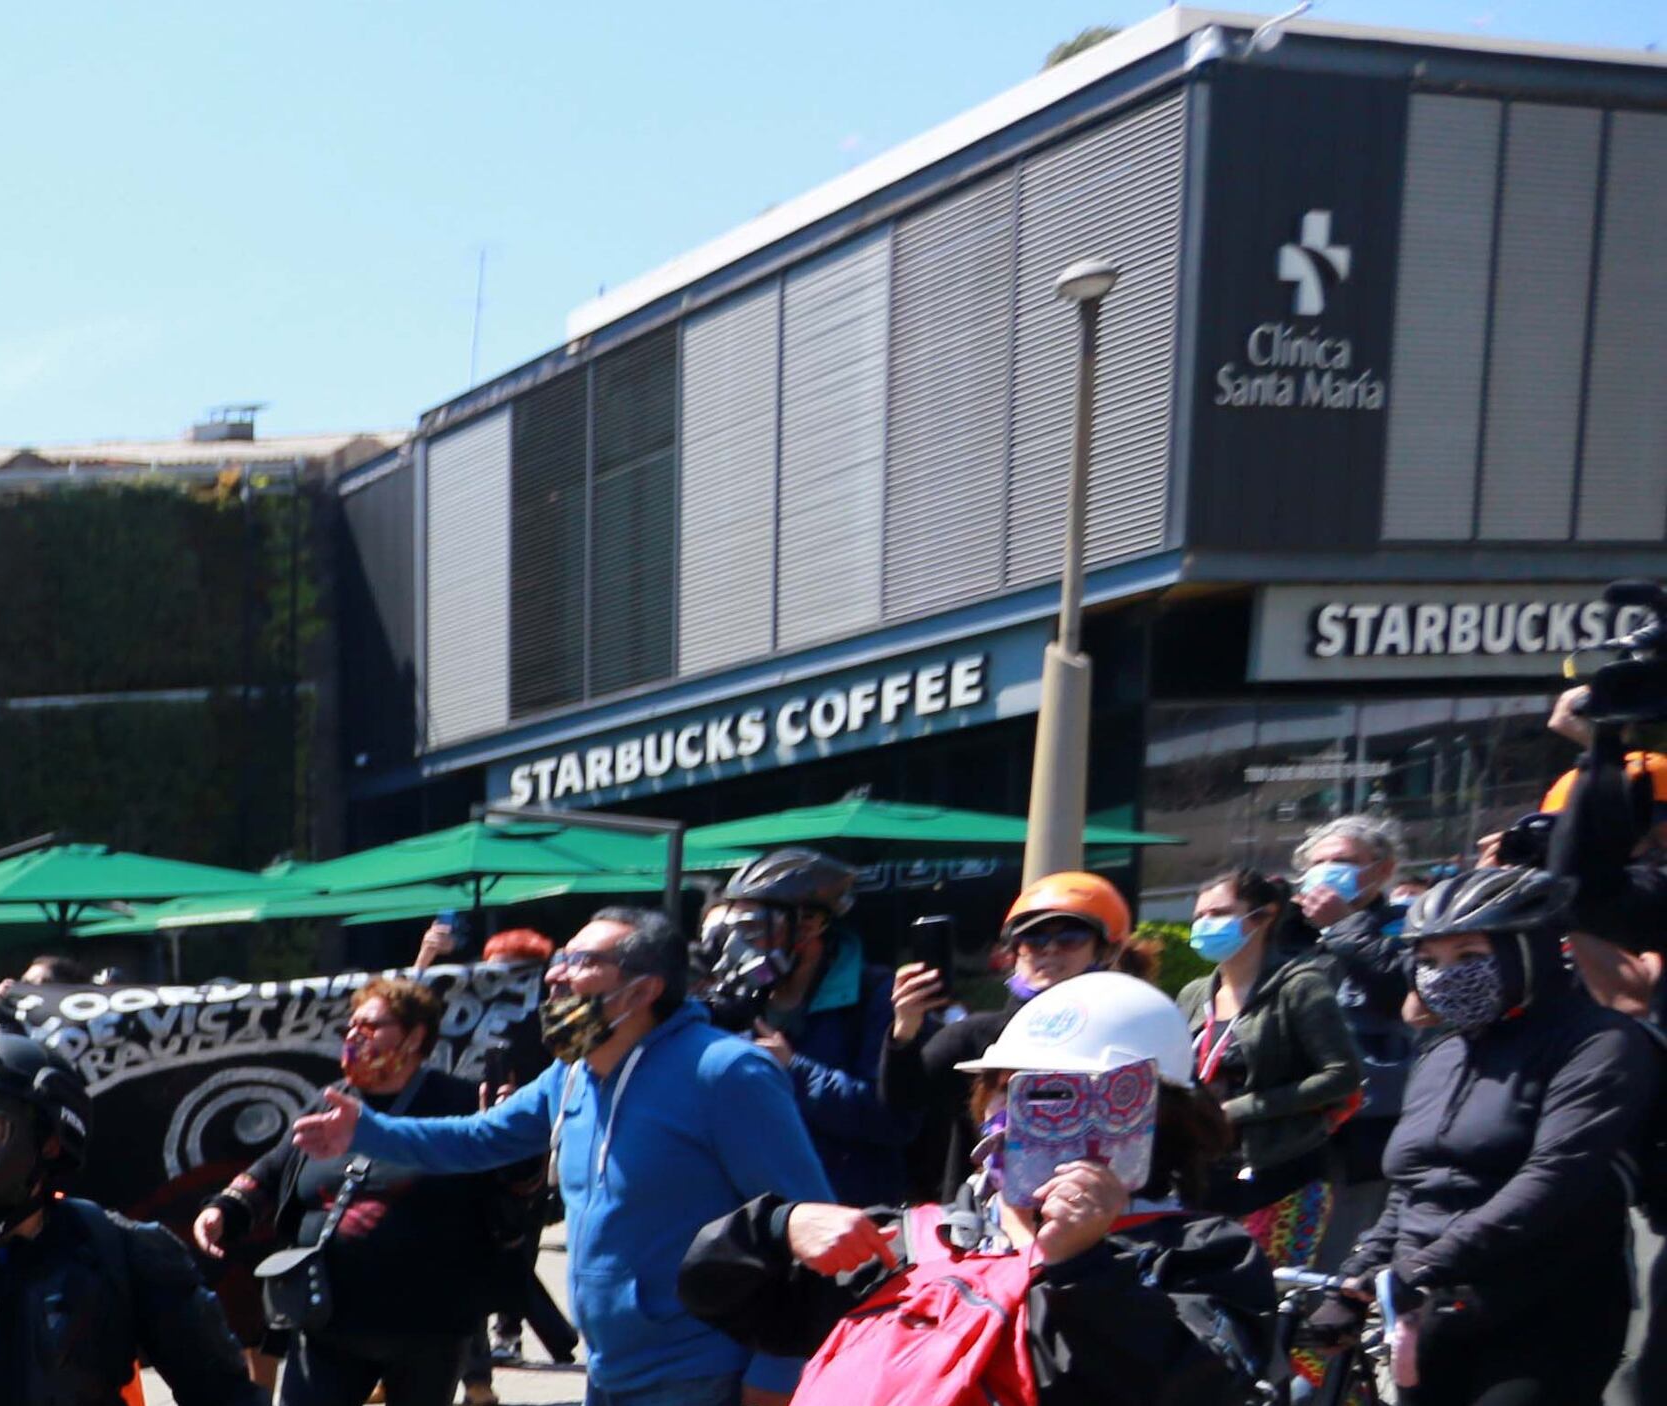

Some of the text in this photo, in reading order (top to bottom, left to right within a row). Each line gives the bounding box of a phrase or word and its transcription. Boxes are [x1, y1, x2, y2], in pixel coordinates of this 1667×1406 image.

[1247, 322, 1351, 369] Clínica
[1215, 363, 1384, 409] Santa María
[1315, 600, 1608, 657] STARBUCKS
[509, 654, 985, 808] STARBUCKS COFFEE
